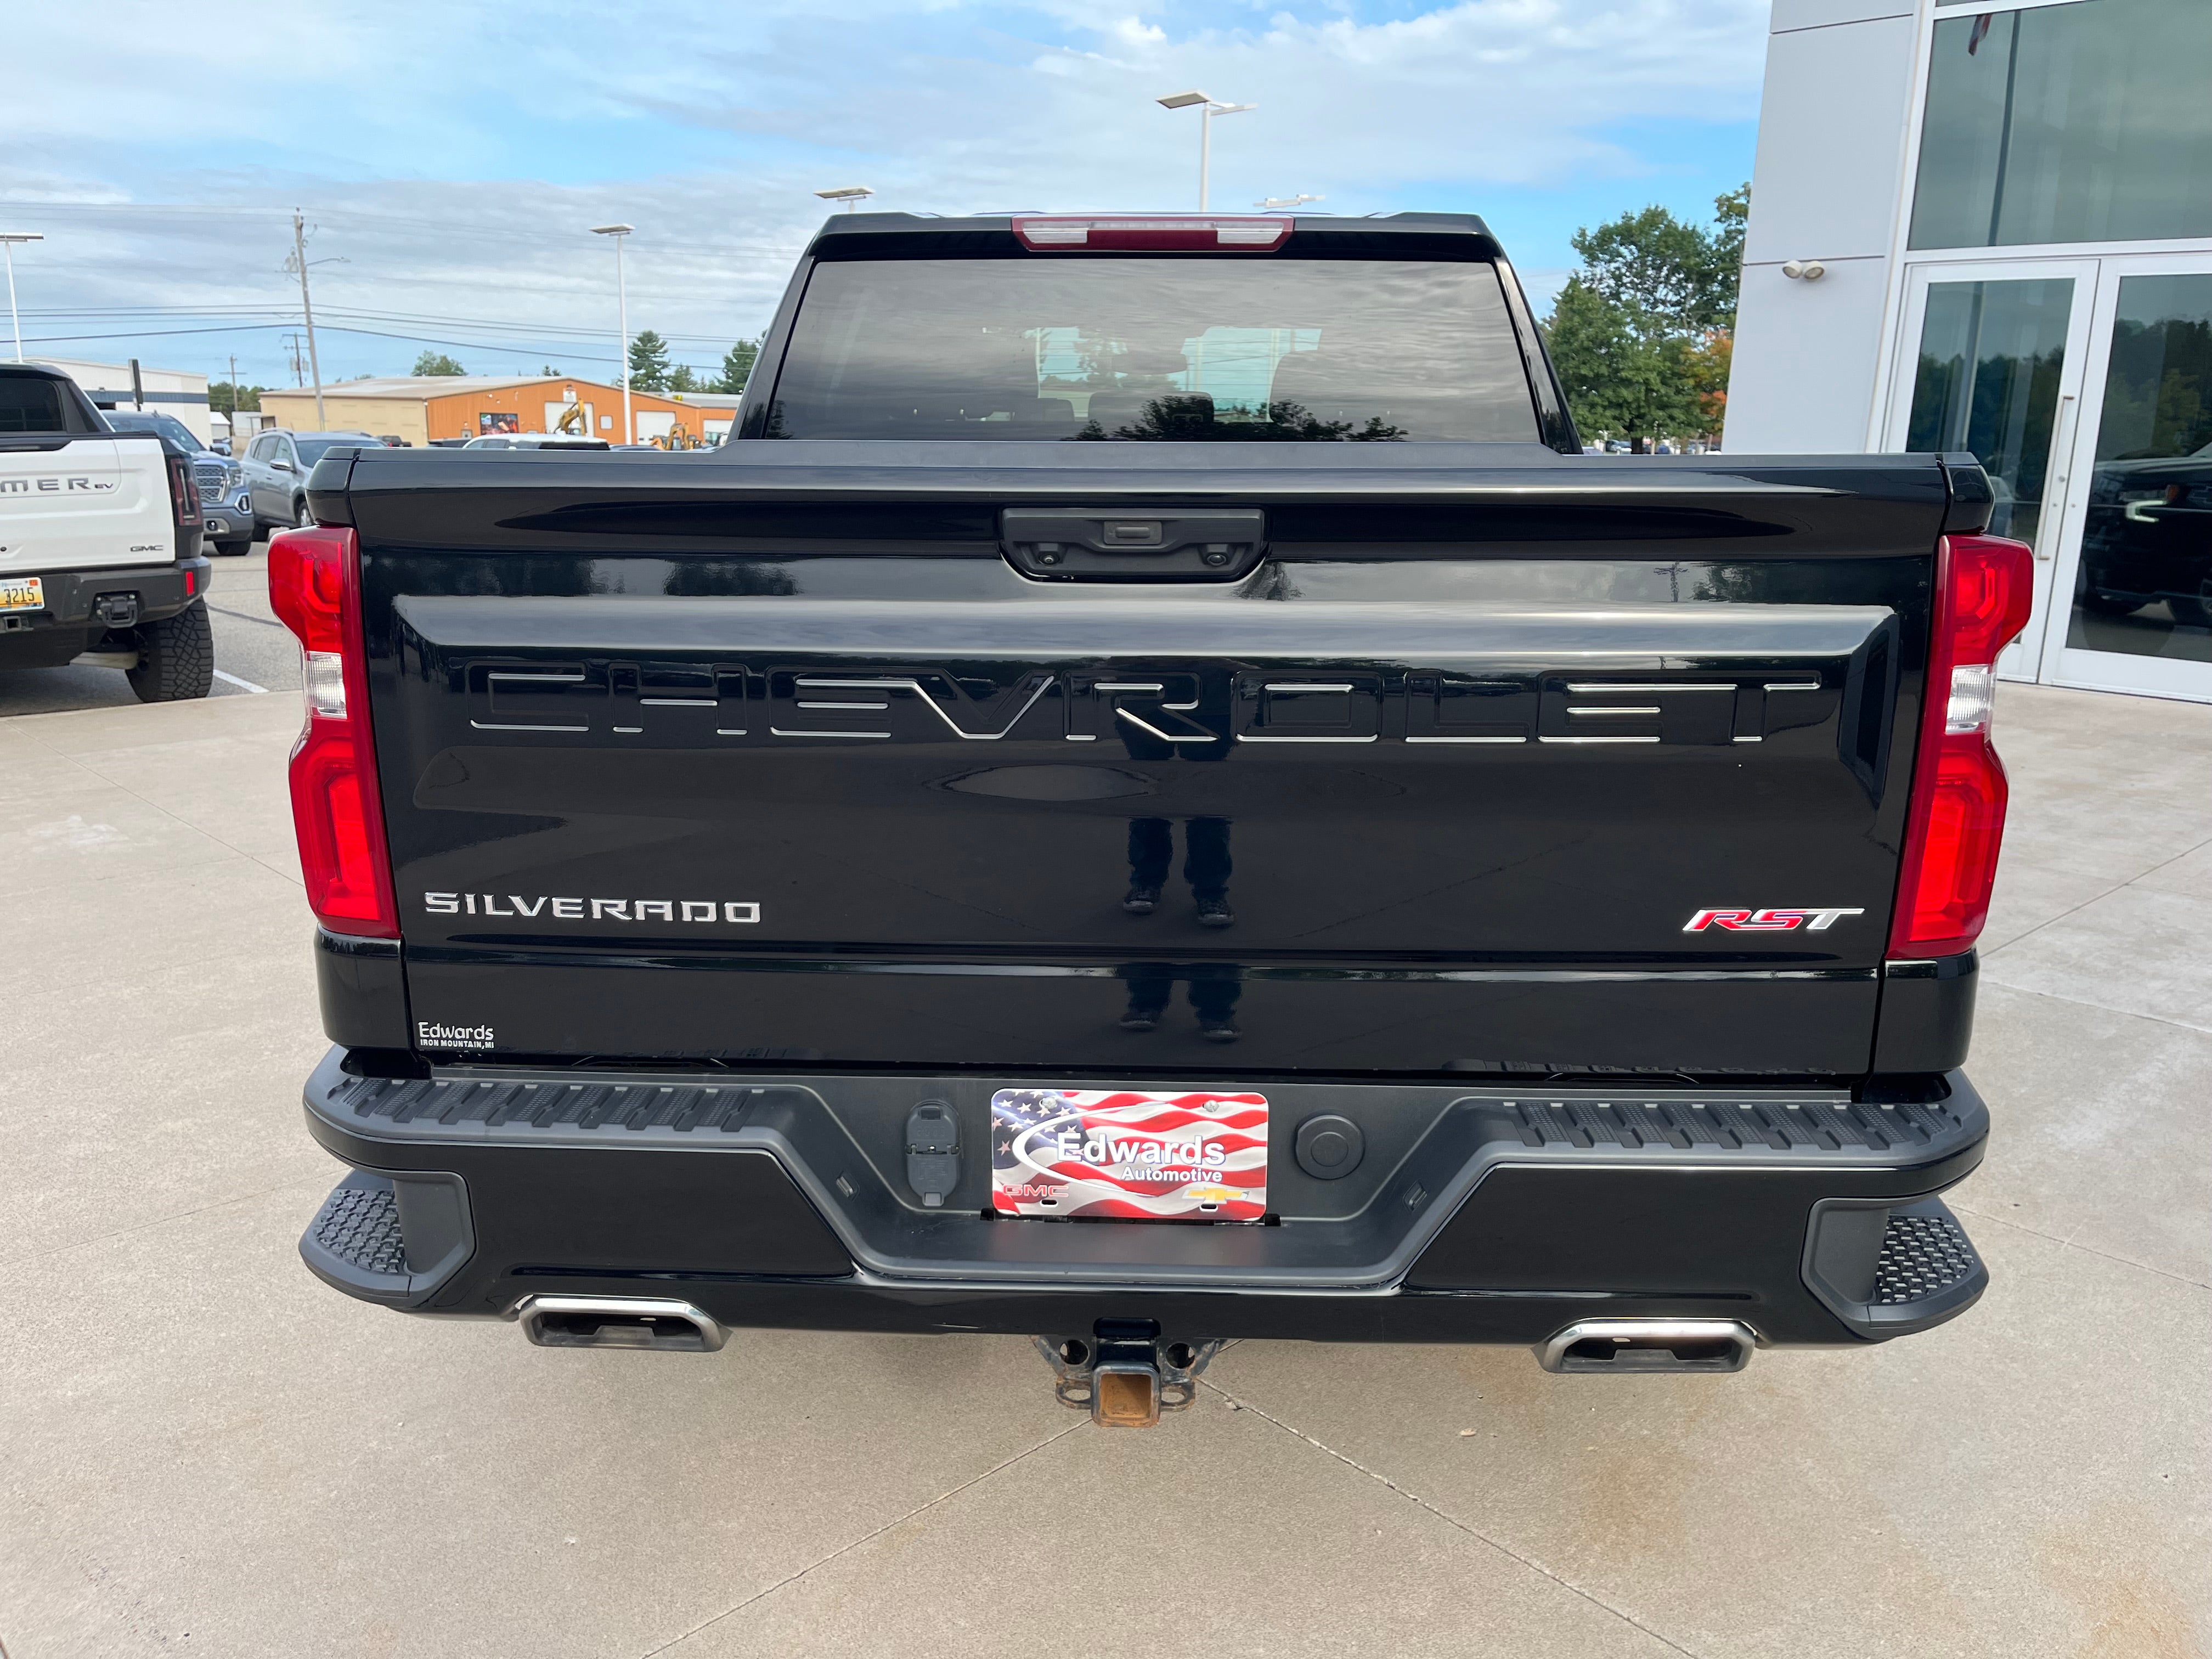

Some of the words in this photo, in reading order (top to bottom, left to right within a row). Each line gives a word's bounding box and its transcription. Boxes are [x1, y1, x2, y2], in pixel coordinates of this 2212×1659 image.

[466, 660, 1822, 743] CHEVROLET
[425, 891, 761, 923] SILVERADO
[1682, 908, 1865, 932] RST
[418, 1022, 494, 1040] Edwards
[1057, 1132, 1226, 1165] Edwards
[1121, 1166, 1223, 1182] Automotive
[1002, 1184, 1069, 1197] GMC
